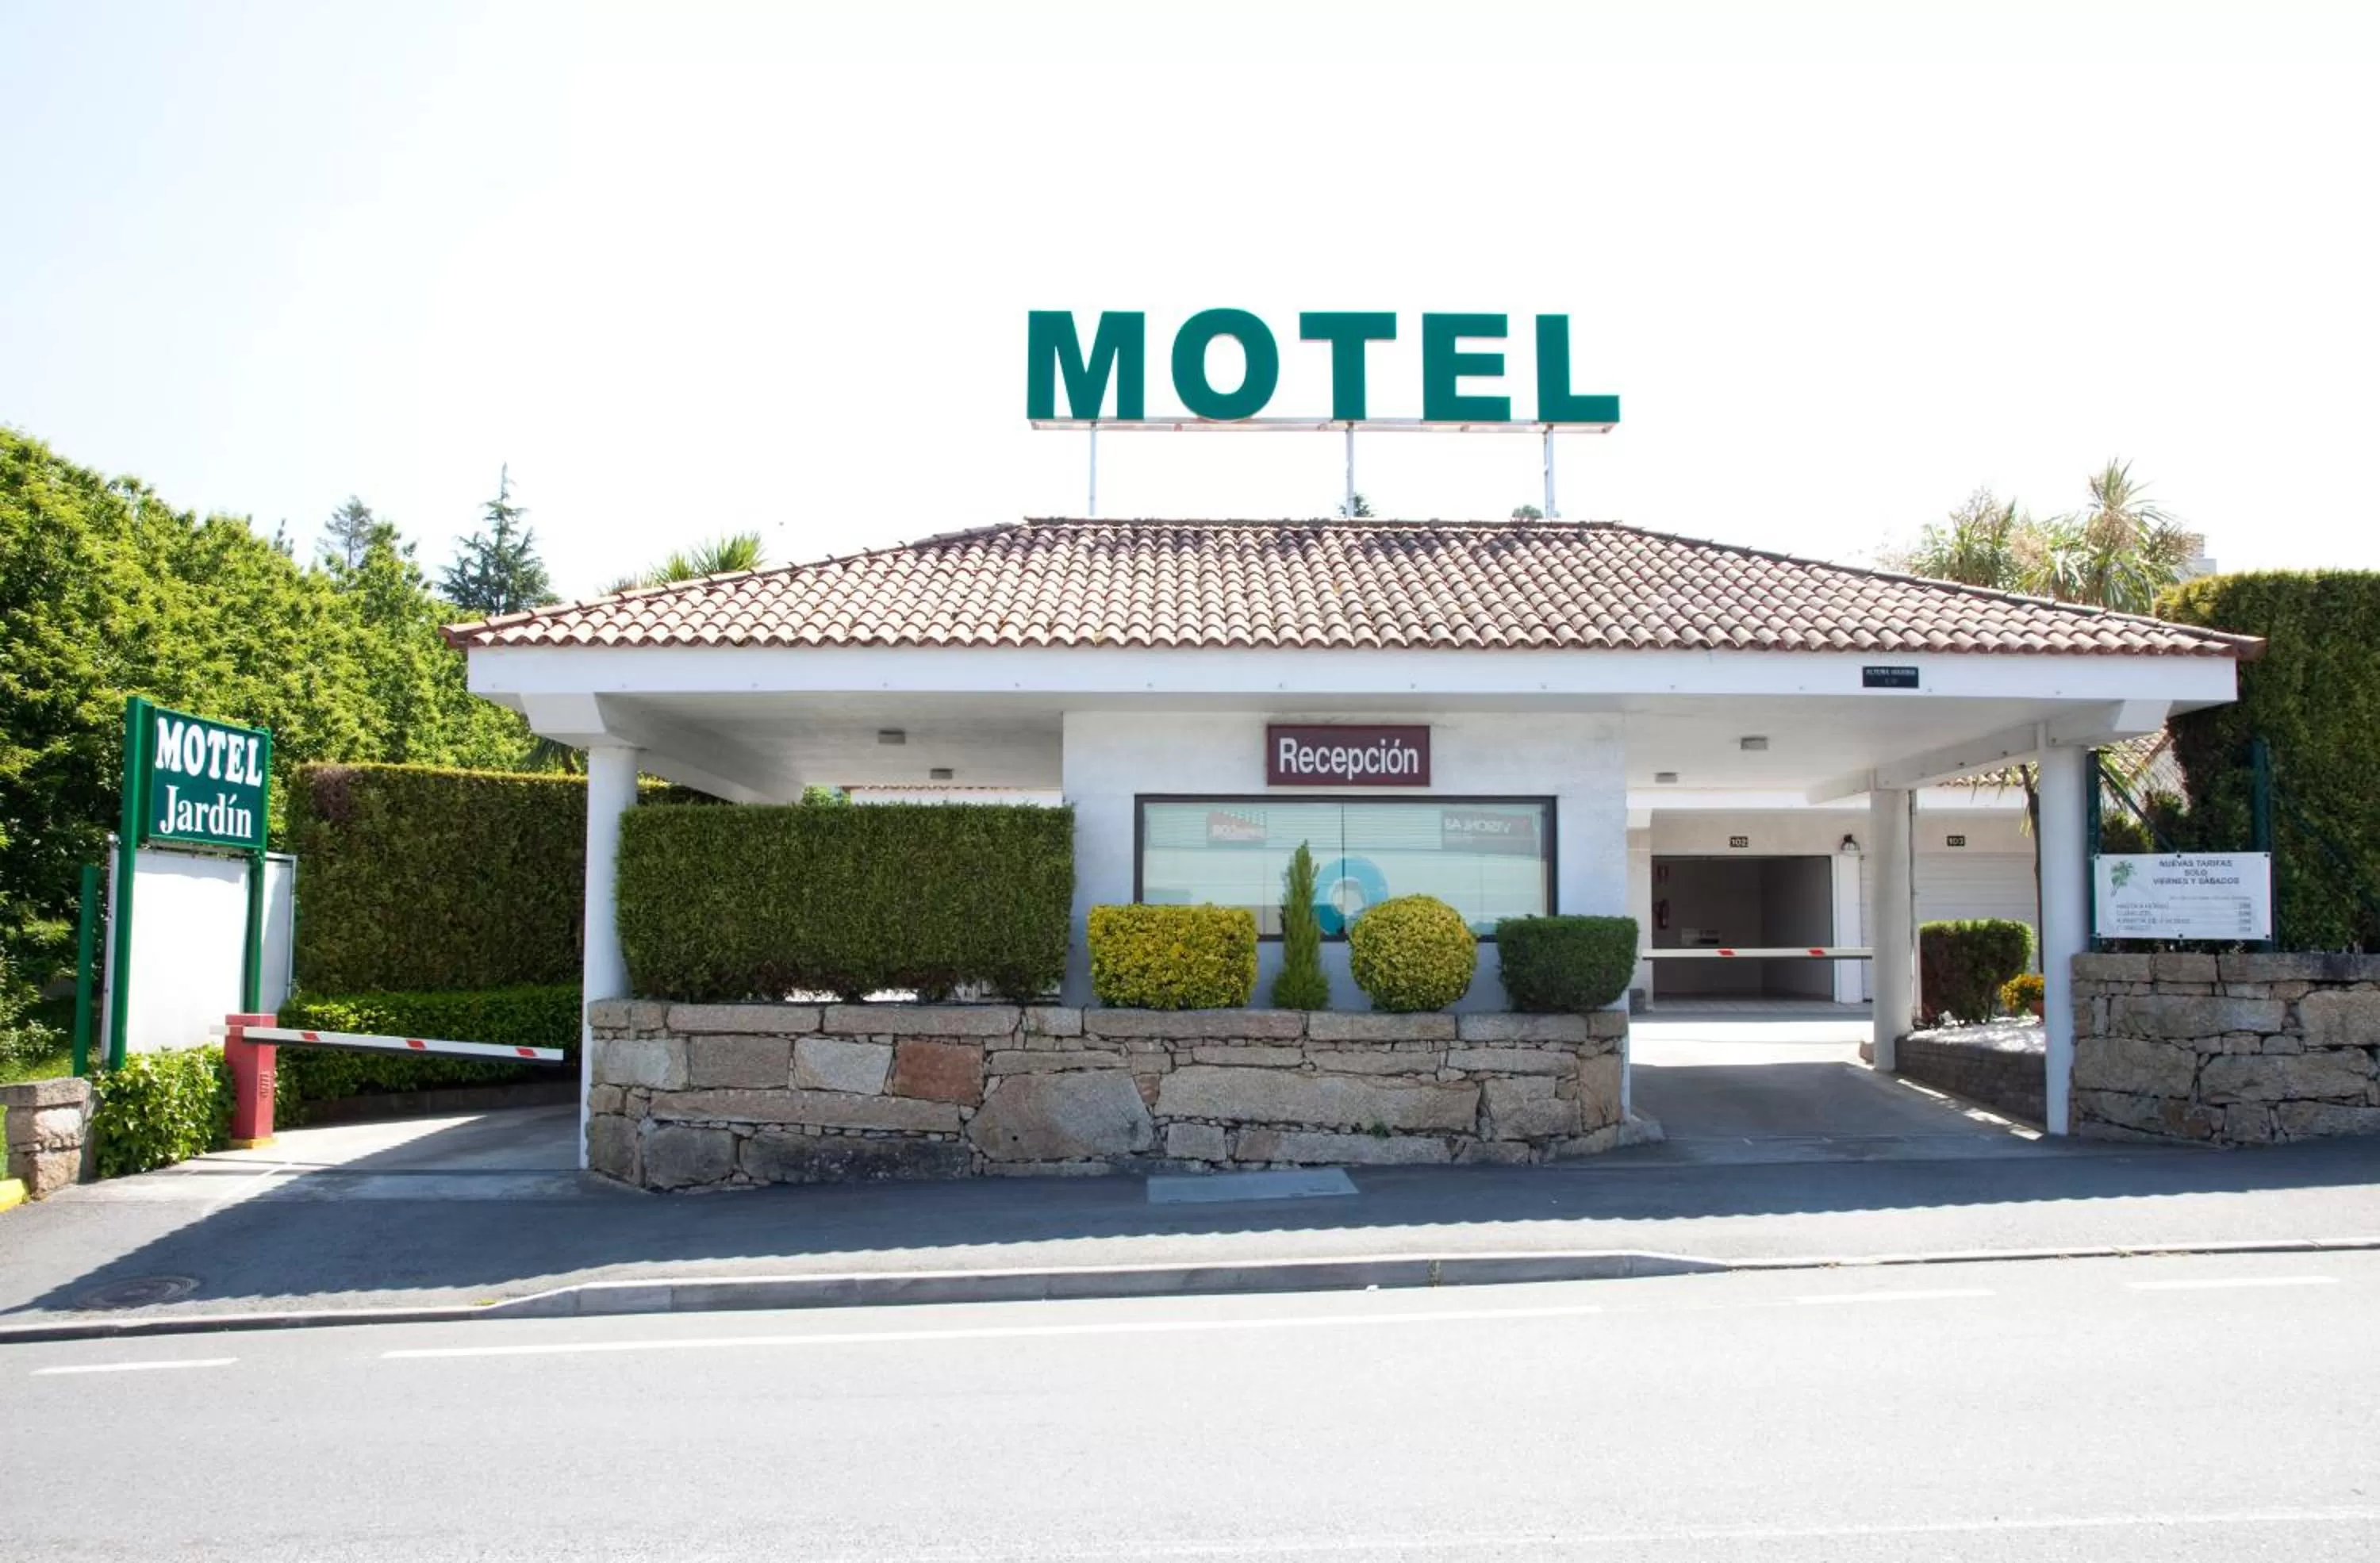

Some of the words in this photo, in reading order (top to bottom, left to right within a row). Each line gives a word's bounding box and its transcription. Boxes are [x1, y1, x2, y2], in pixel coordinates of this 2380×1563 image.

[1027, 307, 1620, 424] MOTEL
[155, 716, 263, 788] MOTEL
[1279, 738, 1418, 780] Recepción
[159, 784, 252, 839] Jardín
[1731, 838, 1746, 847] 102
